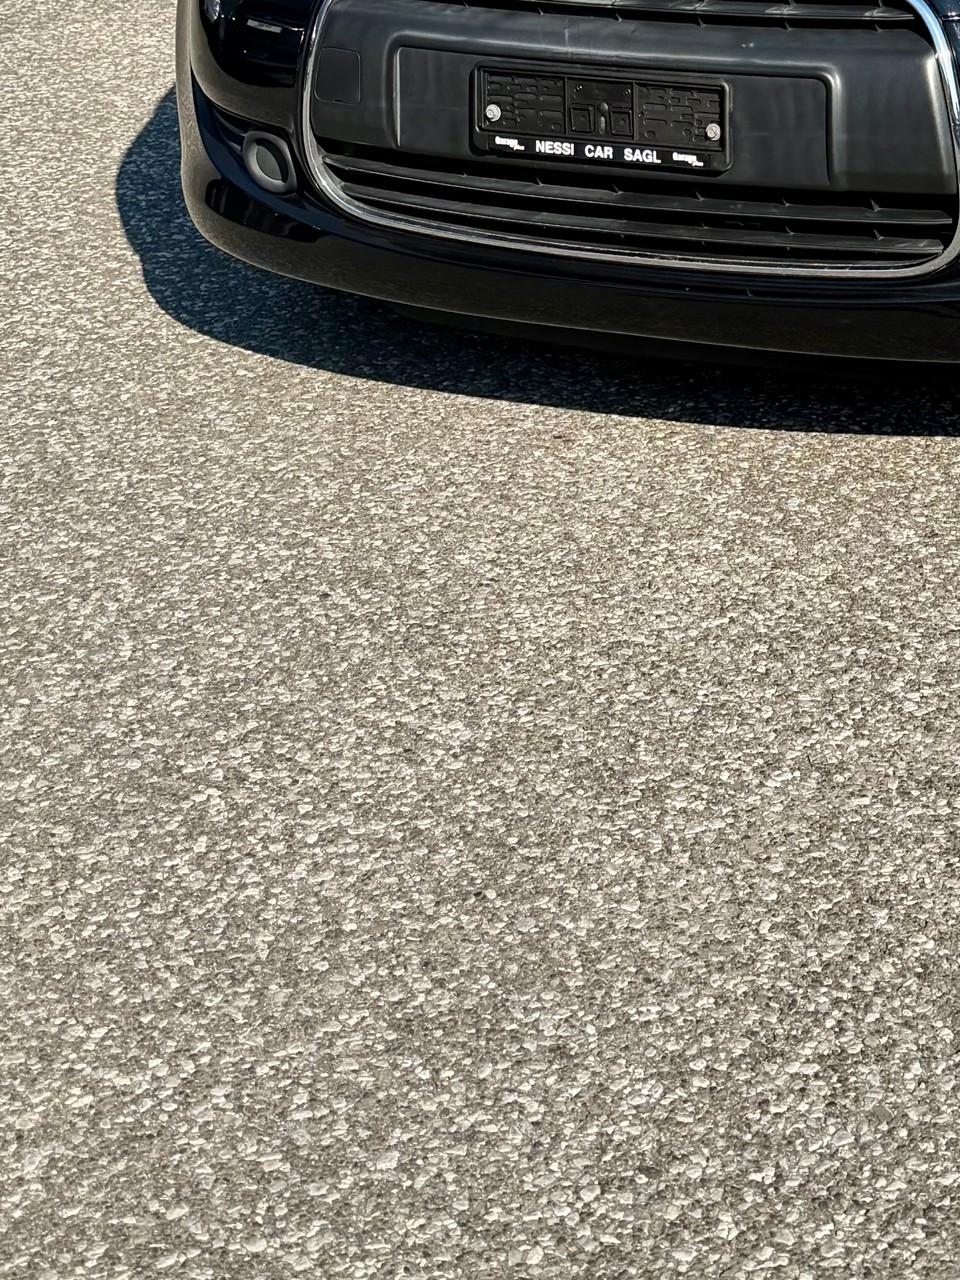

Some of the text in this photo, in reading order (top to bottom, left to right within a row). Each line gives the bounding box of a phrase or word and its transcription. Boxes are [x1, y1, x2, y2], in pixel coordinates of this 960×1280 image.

[535, 140, 661, 163] NESSI CAR SAGL
